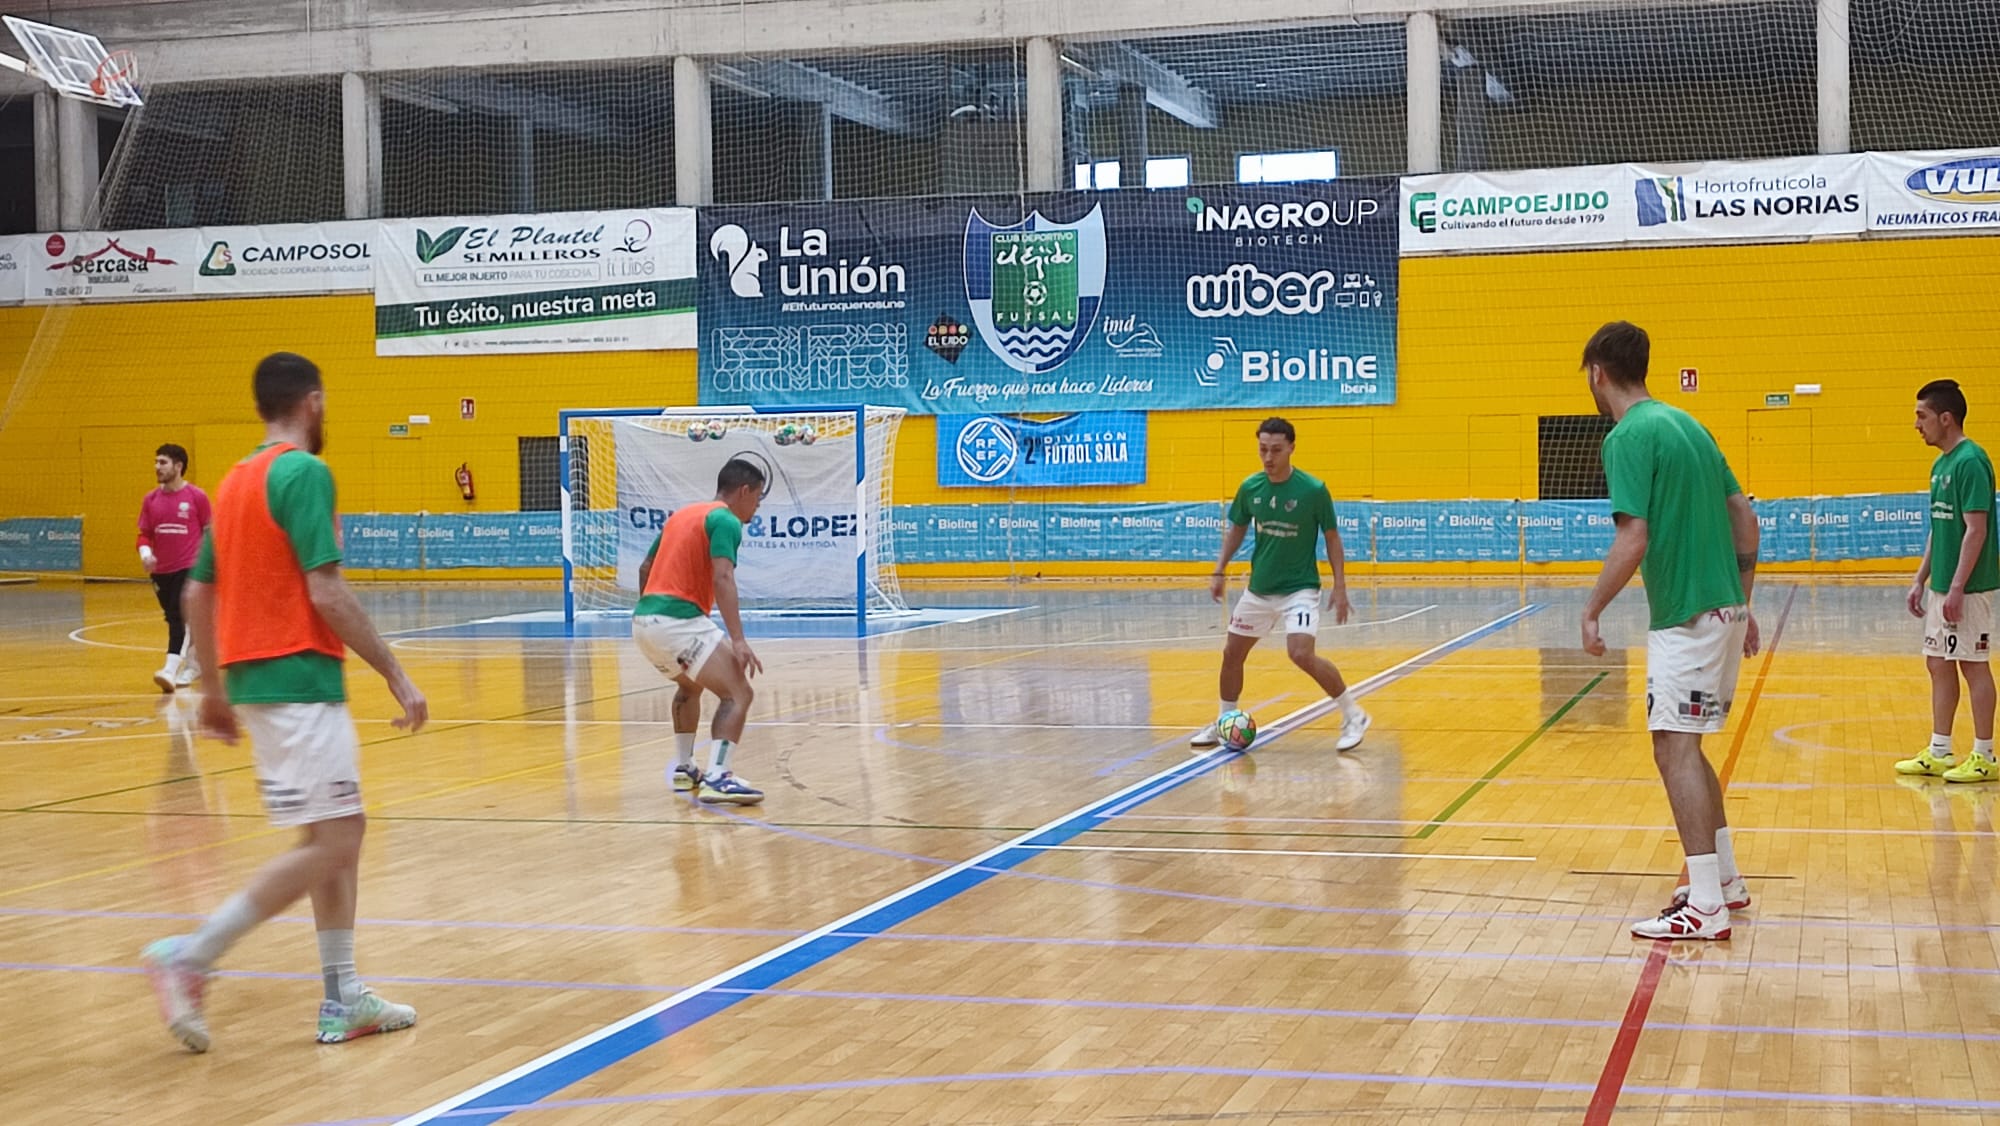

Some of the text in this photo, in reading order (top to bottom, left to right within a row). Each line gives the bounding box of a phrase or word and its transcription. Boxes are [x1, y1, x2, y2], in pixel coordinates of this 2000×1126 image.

[1442, 190, 1609, 217] CAMPOEJIDO
[1695, 194, 1859, 218] LAS NORIAS
[1441, 214, 1605, 230] Cultivando el futuro desde 1979
[1876, 209, 2000, 227] NEUMÁTICOS FRA
[465, 224, 605, 249] El Plantel
[780, 226, 828, 257] La
[995, 231, 1074, 243] CLUB DEPORTIVO
[1235, 234, 1323, 247] BIOTECH
[242, 243, 371, 263] CAMPOSOL
[464, 249, 600, 263] SEMILLEROS
[72, 255, 149, 273] Sercasa
[424, 273, 434, 282] EL
[436, 271, 467, 282] MEJOR
[470, 271, 507, 281] INJERTO
[509, 270, 534, 279] PARA
[535, 270, 547, 278] TU
[1187, 264, 1335, 317] wiber
[414, 289, 656, 327] Tu éxito, nuestra meta
[1103, 314, 1136, 333] imd
[928, 335, 969, 346] EL EJIDO
[1242, 348, 1377, 382] Bioline
[921, 378, 941, 401] La
[943, 376, 998, 402] Fuerza
[1001, 384, 1030, 400] que
[1031, 383, 1056, 395] nos
[1059, 377, 1096, 394] hace
[975, 438, 997, 449] RF
[976, 451, 997, 461] EF
[1095, 442, 1128, 463] SALA
[1060, 517, 1100, 528] Bioline
[1122, 517, 1164, 528] Bioline
[1383, 516, 1427, 528] Bioline
[1449, 515, 1494, 527] Bioline
[1517, 515, 1564, 528] Bioline
[1801, 513, 1849, 526] Bioline
[1874, 509, 1922, 523] Bioline
[938, 519, 978, 530] Bioline
[999, 518, 1039, 529] Bioline
[362, 527, 399, 538] Bioline
[417, 527, 454, 538] Bioline
[473, 526, 510, 537] Bioline
[1297, 612, 1310, 627] 11
